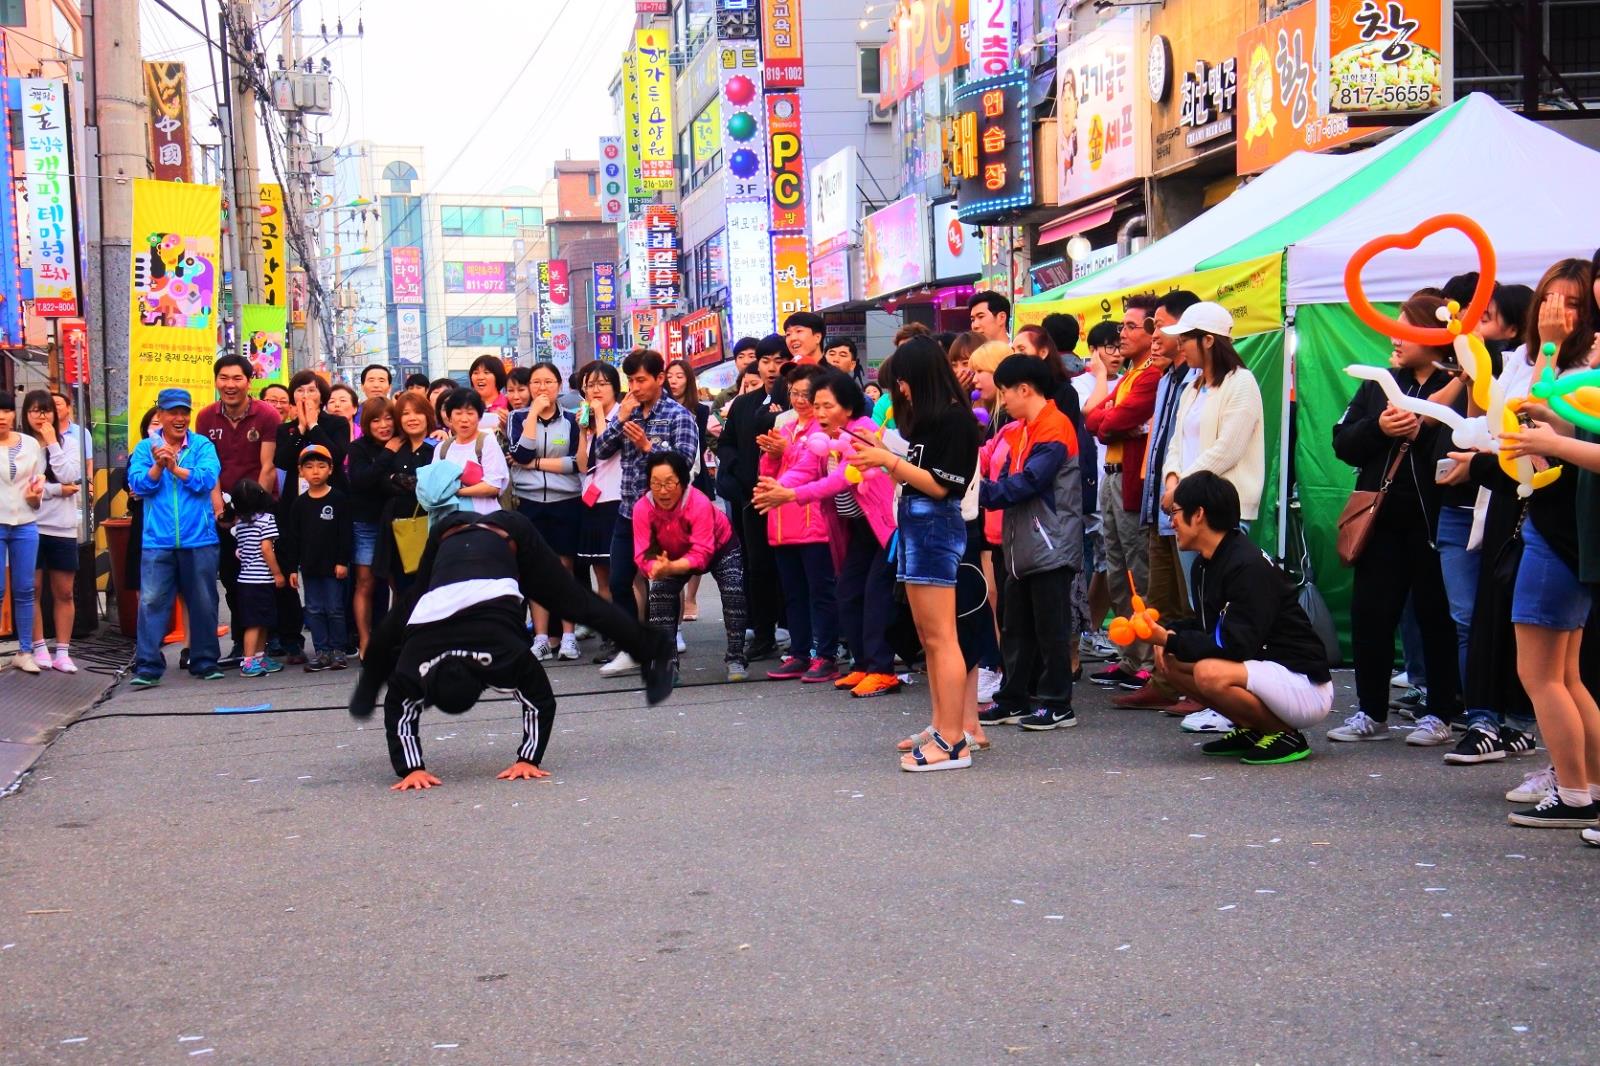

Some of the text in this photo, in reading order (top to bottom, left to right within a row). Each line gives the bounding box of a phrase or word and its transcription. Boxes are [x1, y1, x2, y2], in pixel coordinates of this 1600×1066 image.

[980, 0, 1009, 76] 2층
[1353, 1, 1418, 63] 창
[721, 49, 758, 69] 월드
[765, 67, 803, 81] 819-1002
[1079, 48, 1127, 105] 고기굽는
[639, 34, 667, 156] 해가든요양원
[1180, 57, 1237, 126] 최군맥주
[1339, 85, 1430, 105] 817-5655
[981, 89, 1008, 191] 연습장
[1206, 124, 1219, 140] BEER
[29, 136, 64, 153] 도심속
[34, 156, 60, 204] 캠핑
[735, 184, 758, 195] 3F
[395, 264, 419, 277] 타이
[652, 216, 675, 305] 노래연습장
[39, 263, 71, 282] 포차
[395, 283, 420, 296] 스파
[208, 428, 223, 440] 27
